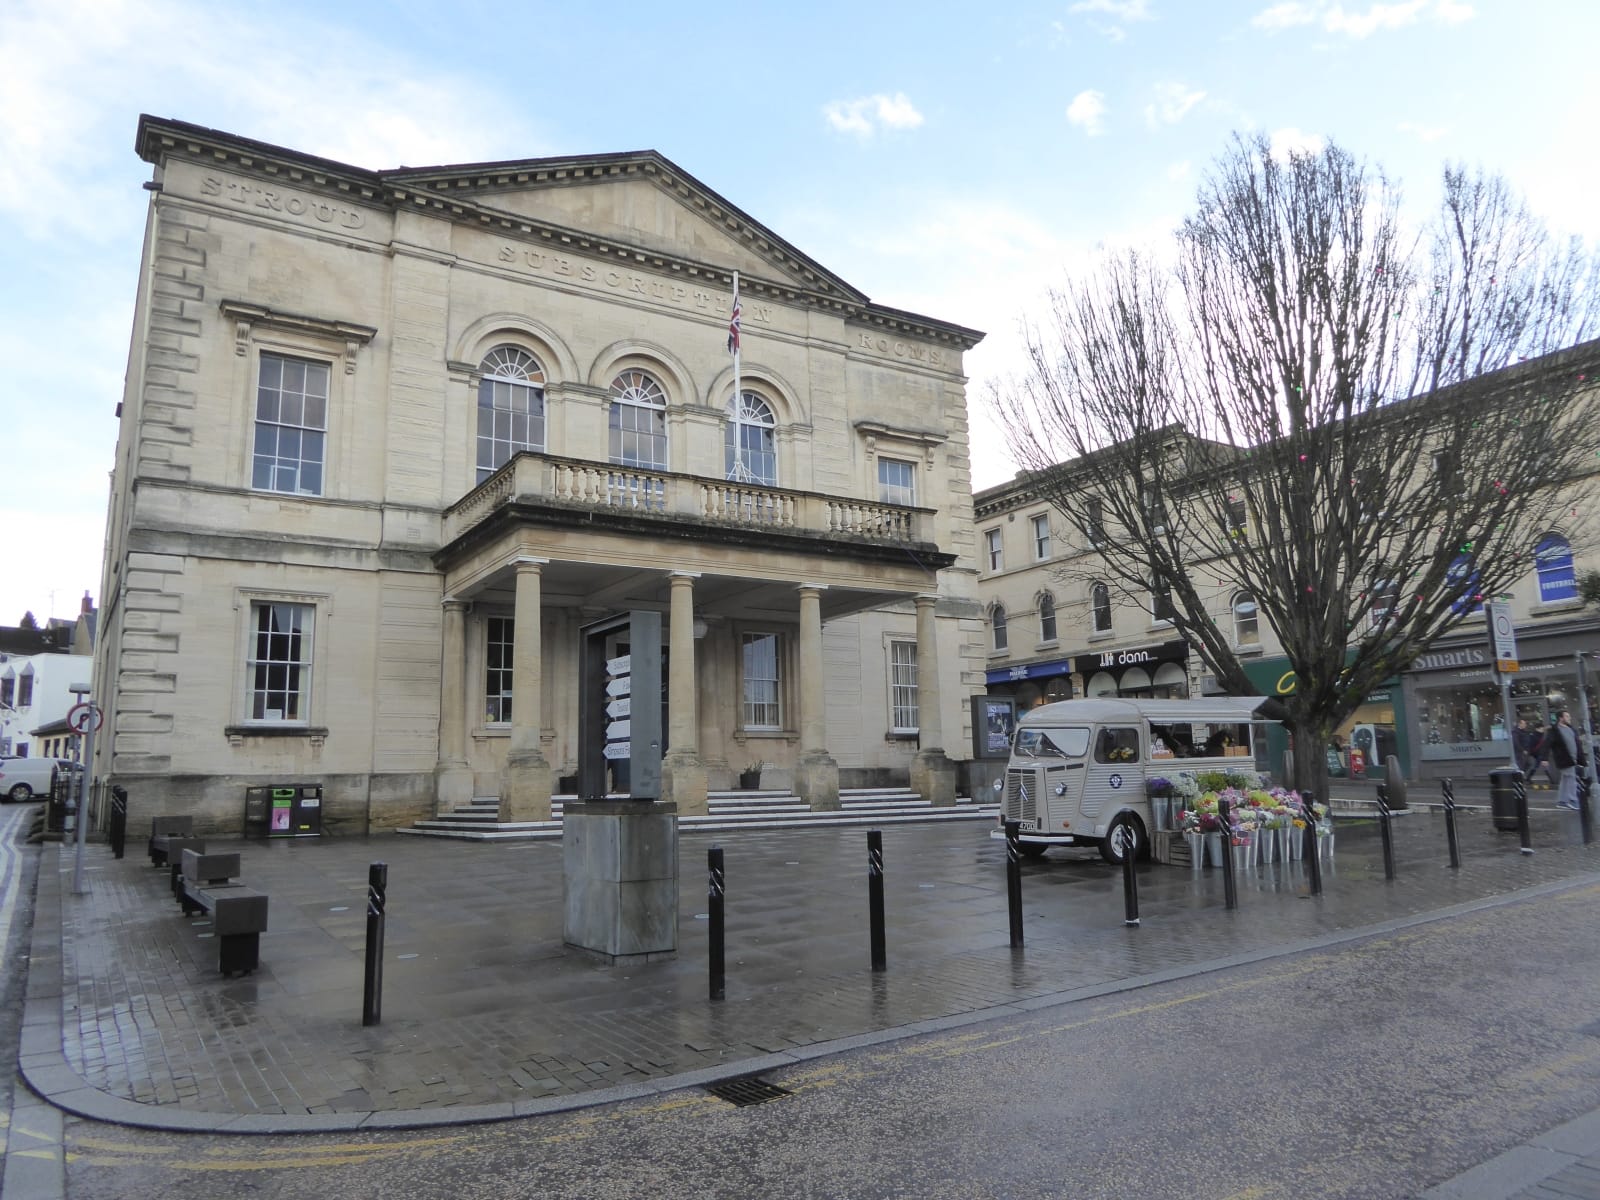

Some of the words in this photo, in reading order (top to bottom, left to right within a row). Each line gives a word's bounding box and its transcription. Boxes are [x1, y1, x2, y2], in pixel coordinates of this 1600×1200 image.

[200, 177, 366, 230] STROUD
[498, 246, 772, 323] SUBSCRIPTIN
[1118, 650, 1148, 665] dann
[1414, 648, 1484, 669] Smarts
